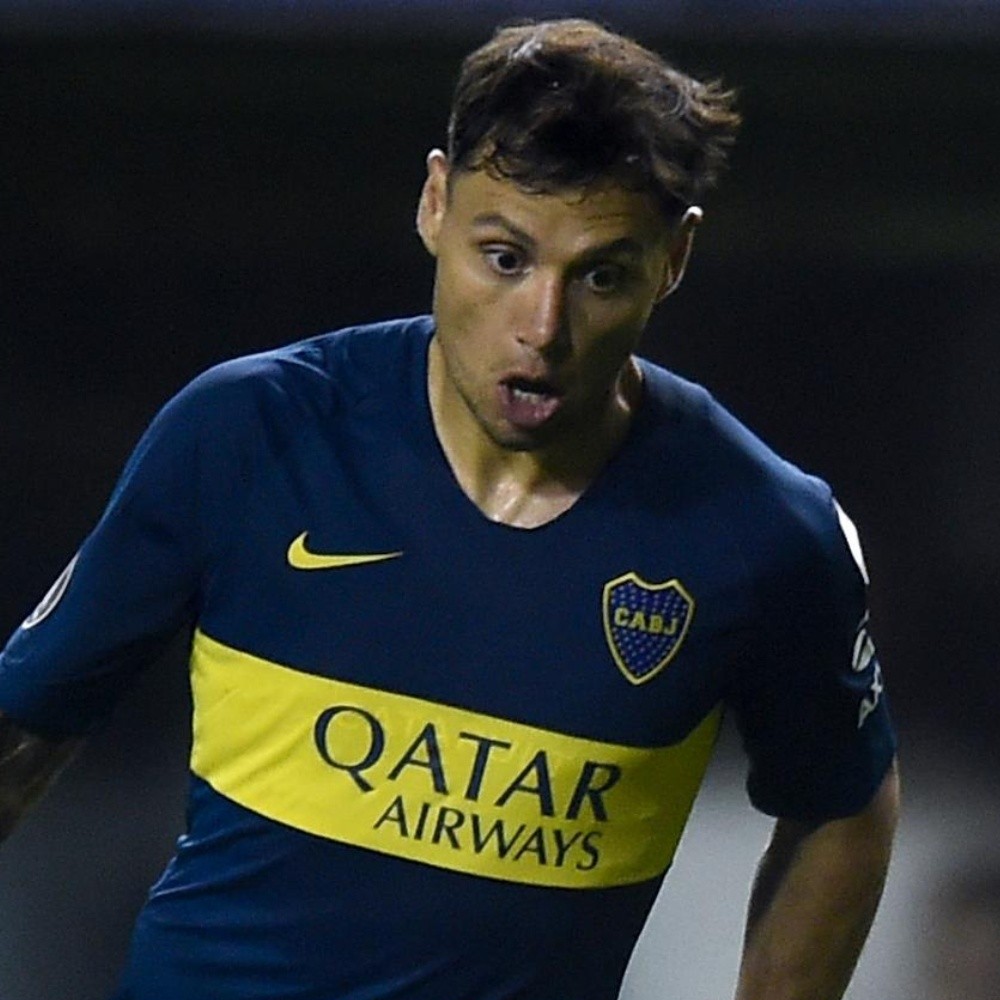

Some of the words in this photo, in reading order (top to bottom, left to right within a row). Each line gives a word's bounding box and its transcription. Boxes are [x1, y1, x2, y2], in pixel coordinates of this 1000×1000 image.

[614, 607, 678, 635] CABJ
[314, 705, 621, 822] QATAR
[373, 795, 603, 871] AIRWAYS
